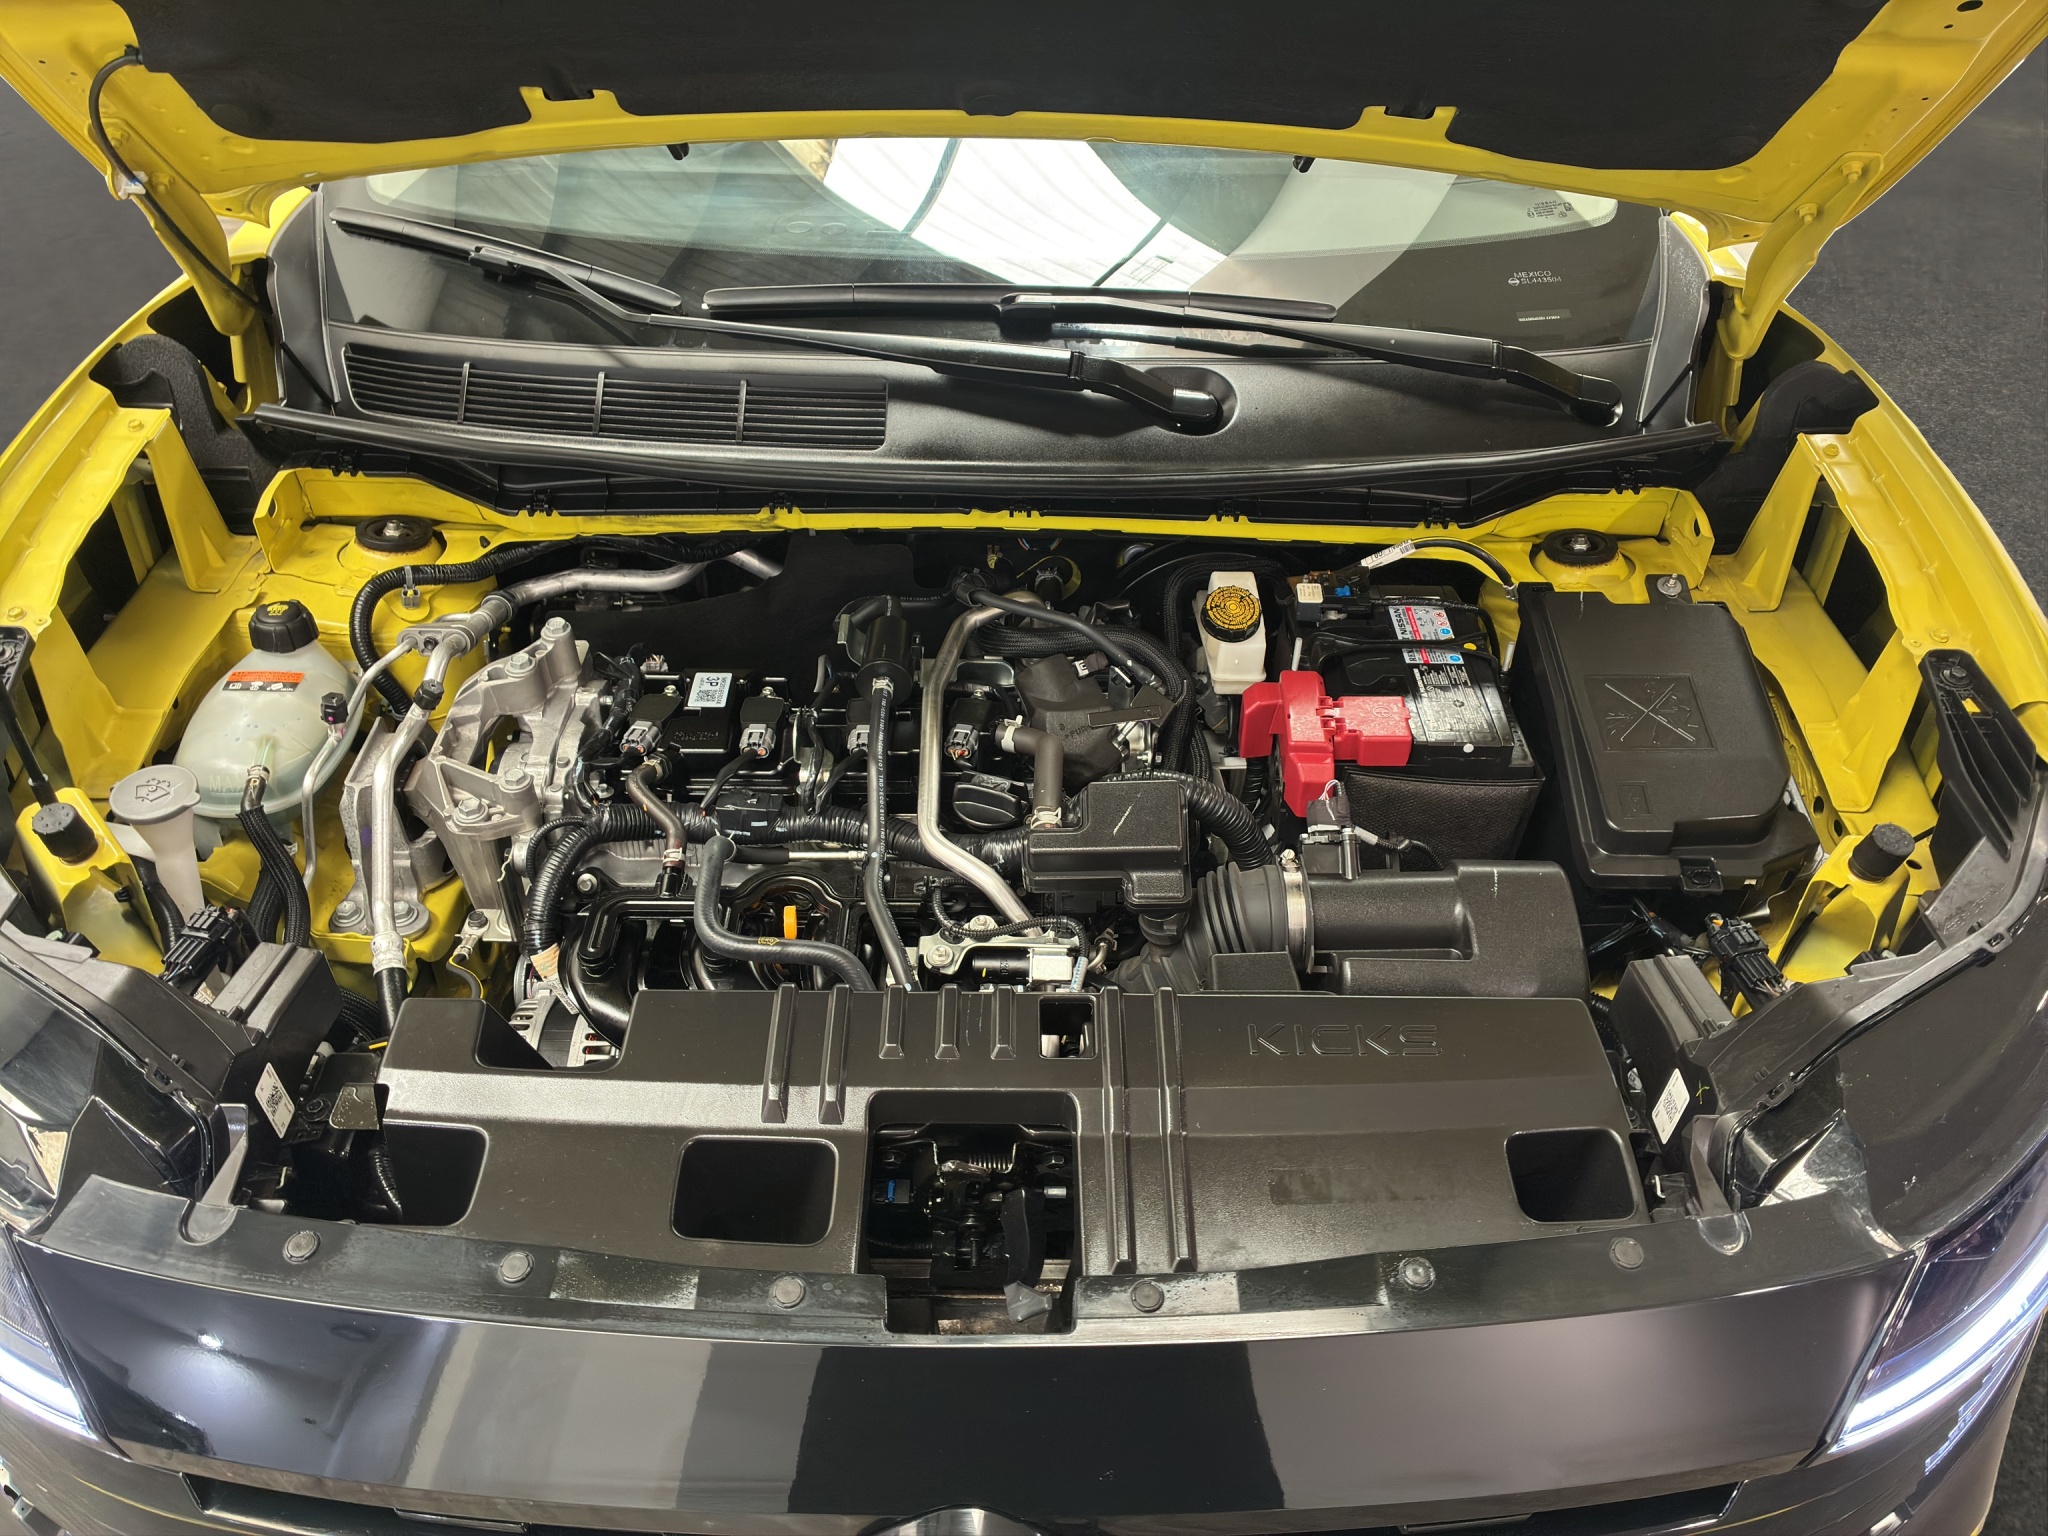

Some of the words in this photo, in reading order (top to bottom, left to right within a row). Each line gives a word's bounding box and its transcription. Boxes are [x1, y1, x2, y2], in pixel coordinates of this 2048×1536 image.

[1513, 270, 1552, 278] MEXICO
[1393, 607, 1410, 636] NISSAN
[705, 676, 720, 687] 3P
[1247, 1022, 1444, 1057] KICKS
